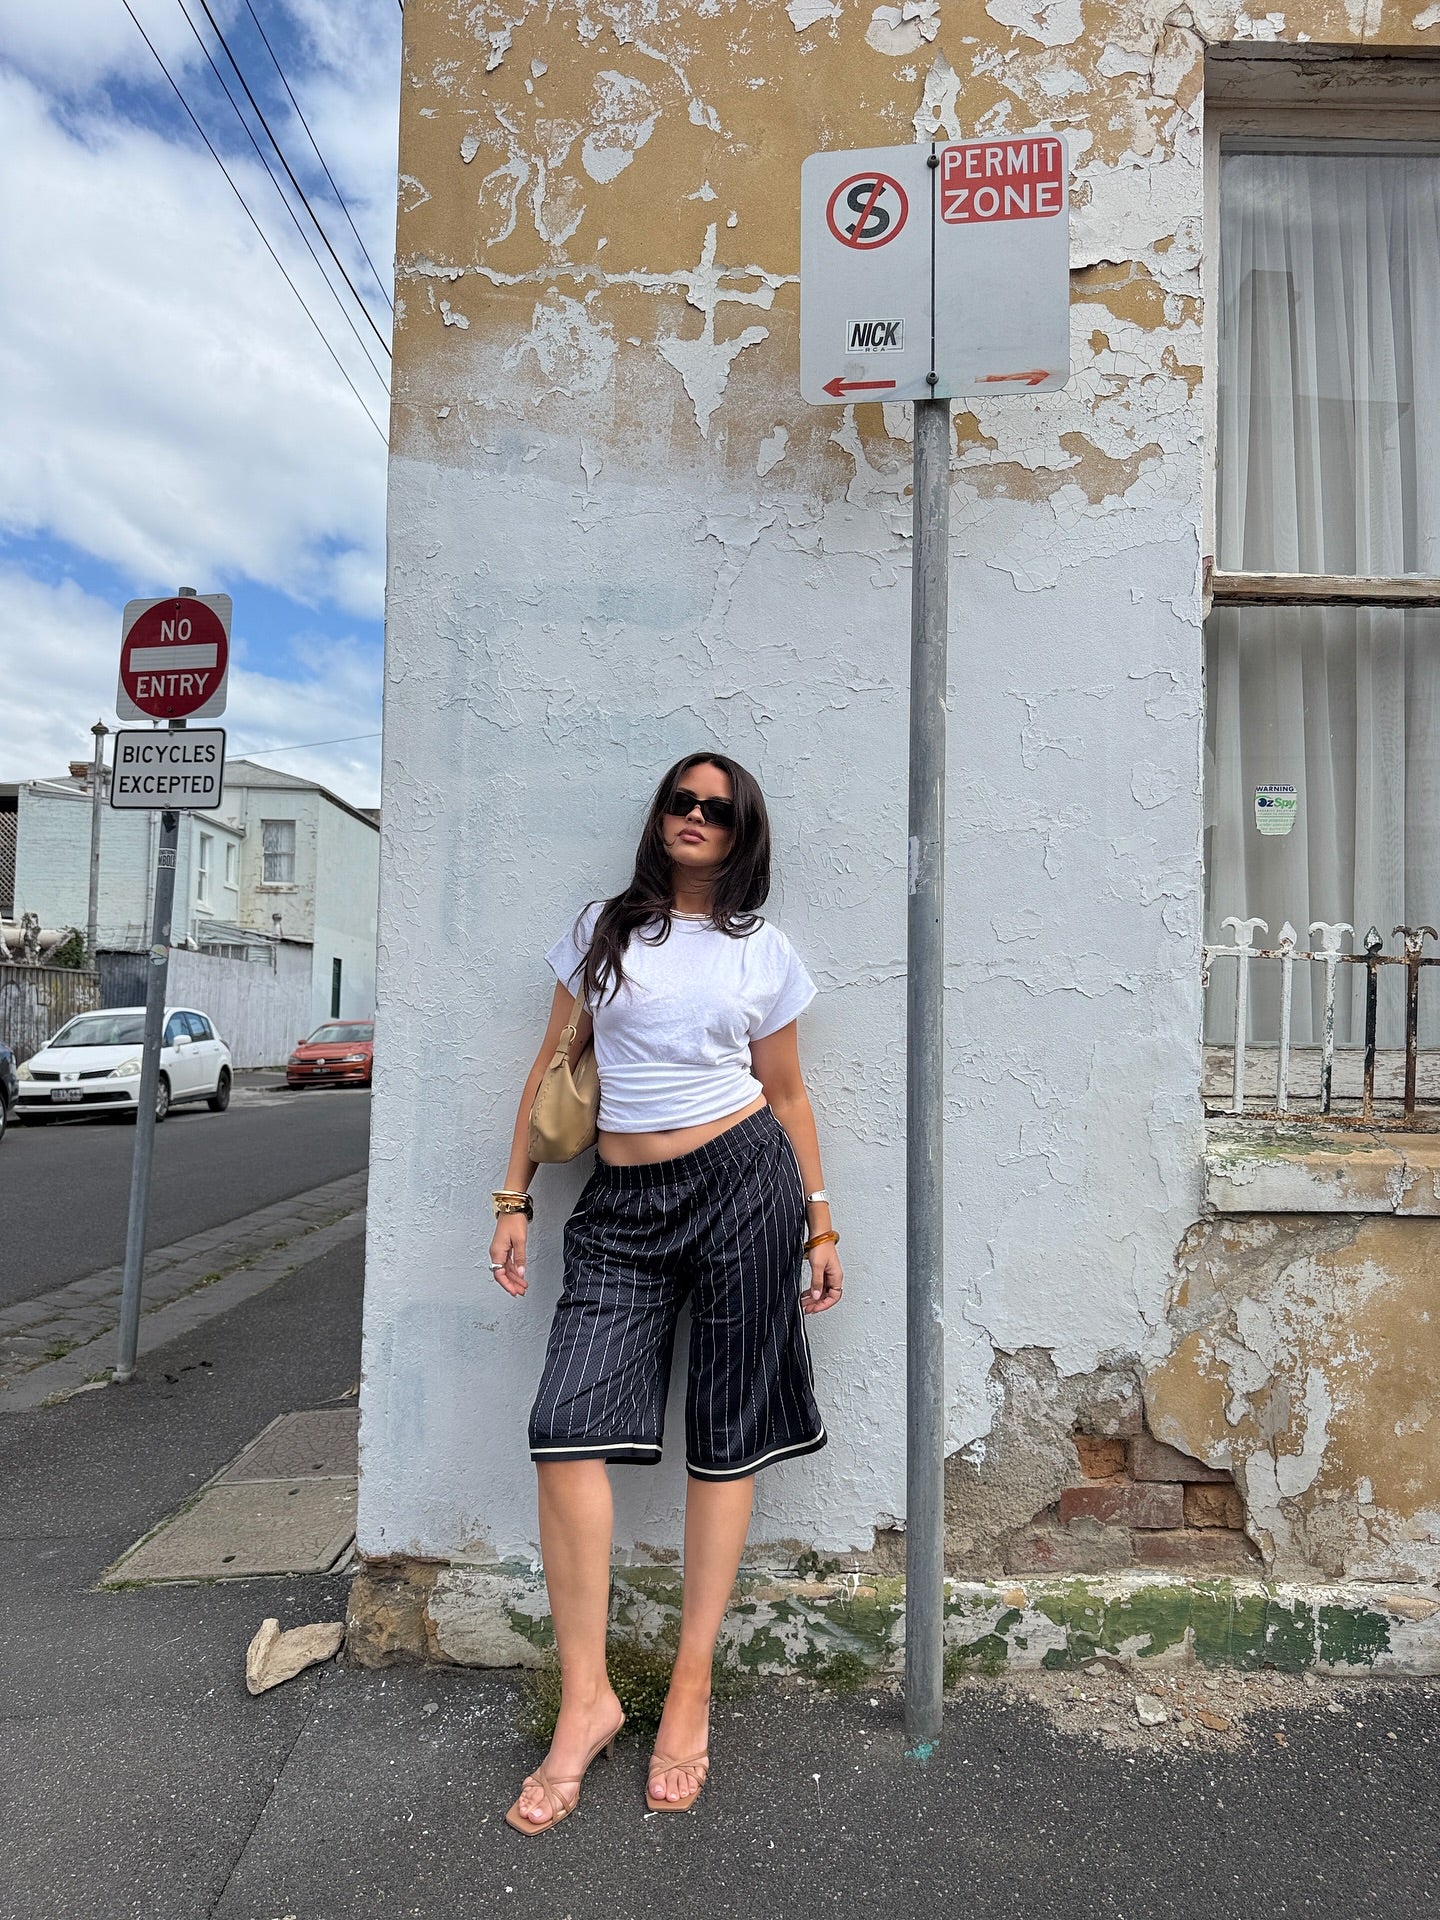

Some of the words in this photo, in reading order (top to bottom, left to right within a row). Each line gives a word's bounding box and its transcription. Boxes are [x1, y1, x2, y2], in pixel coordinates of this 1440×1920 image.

[944, 142, 1058, 180] PERMIT
[845, 183, 890, 239] S
[944, 182, 1060, 219] ZONE
[850, 321, 901, 347] NICK
[160, 618, 192, 642] NO
[136, 672, 210, 699] ENTRY
[122, 745, 216, 763] BICYCLES
[119, 775, 215, 794] EXCEPTED
[1257, 797, 1296, 809] OzSpy
